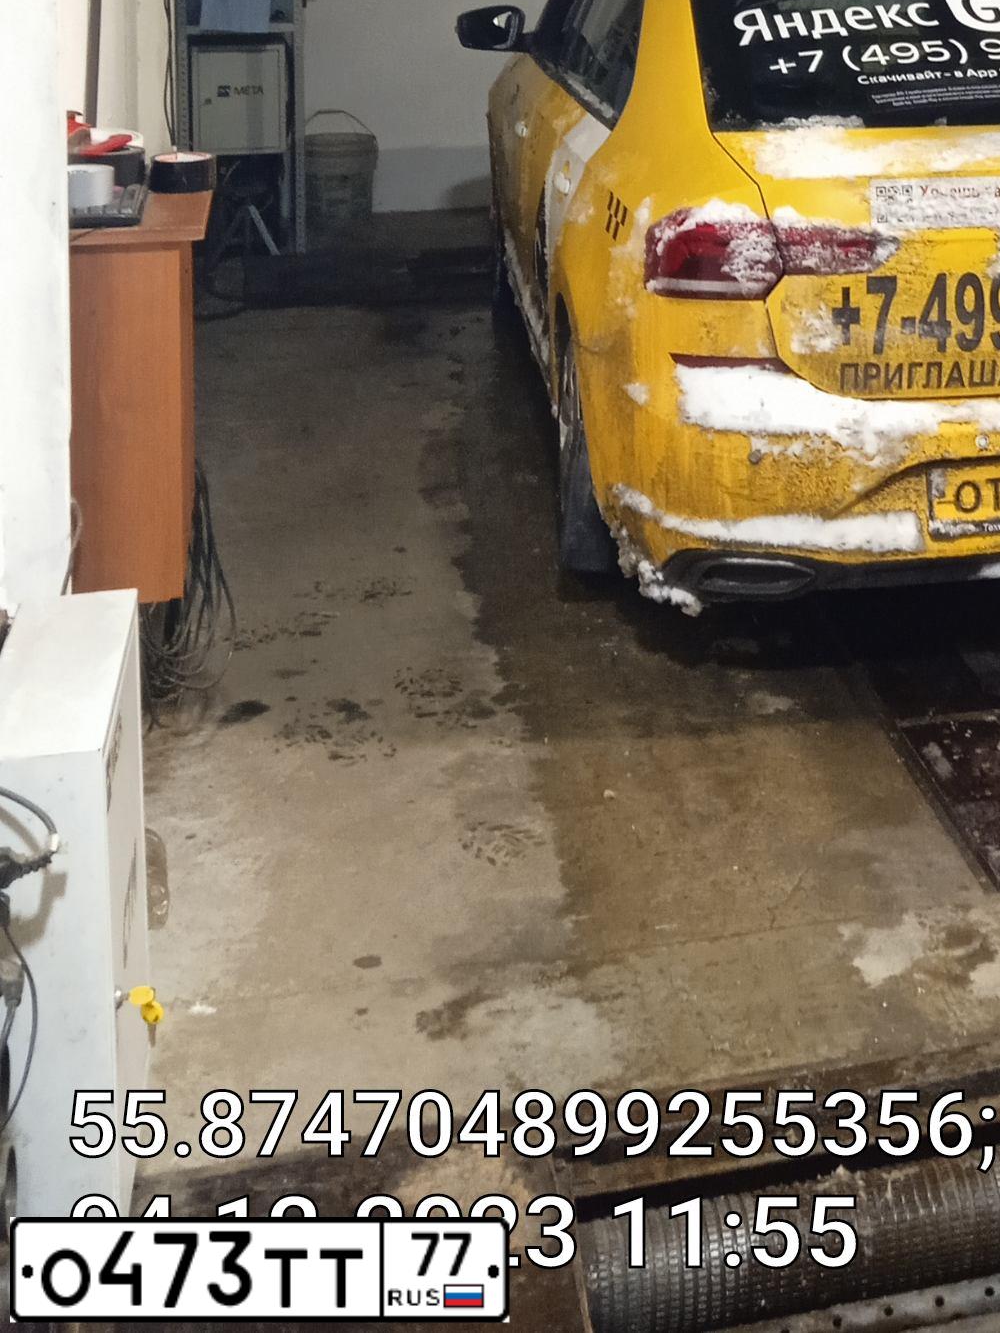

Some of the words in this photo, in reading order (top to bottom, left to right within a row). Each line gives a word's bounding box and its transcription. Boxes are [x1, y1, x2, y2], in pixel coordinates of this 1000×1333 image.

[733, 2, 940, 46] Яндекс
[769, 50, 824, 74] +7
[842, 39, 969, 71] (495)
[966, 68, 998, 79] App
